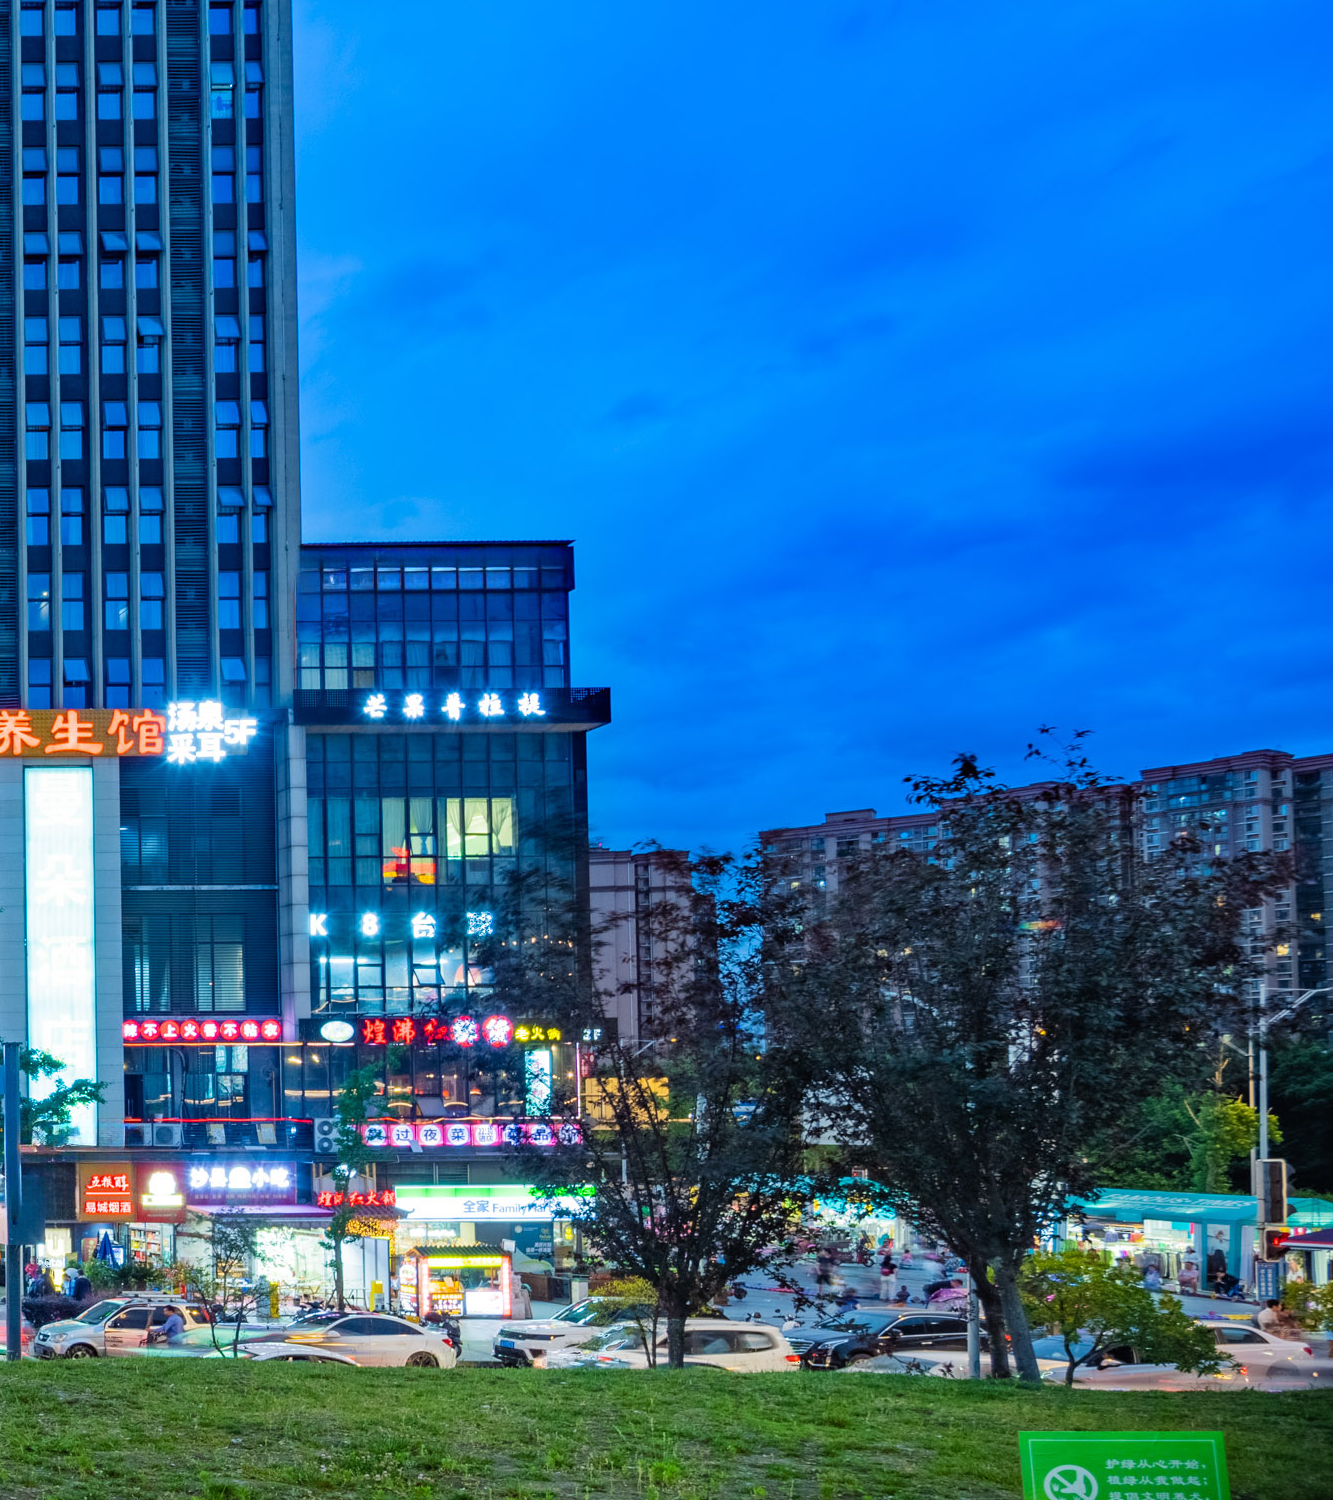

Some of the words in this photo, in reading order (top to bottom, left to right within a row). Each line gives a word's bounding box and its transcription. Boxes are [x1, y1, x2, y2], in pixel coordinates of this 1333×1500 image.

[167, 701, 224, 732] 汤泉
[363, 692, 546, 720] 芒果普拉提
[223, 719, 256, 745] 5F
[167, 733, 226, 763] 采耳
[252, 1167, 290, 1188] 小吃
[85, 1201, 131, 1213] 易城烟酒
[463, 1199, 489, 1213] 全家
